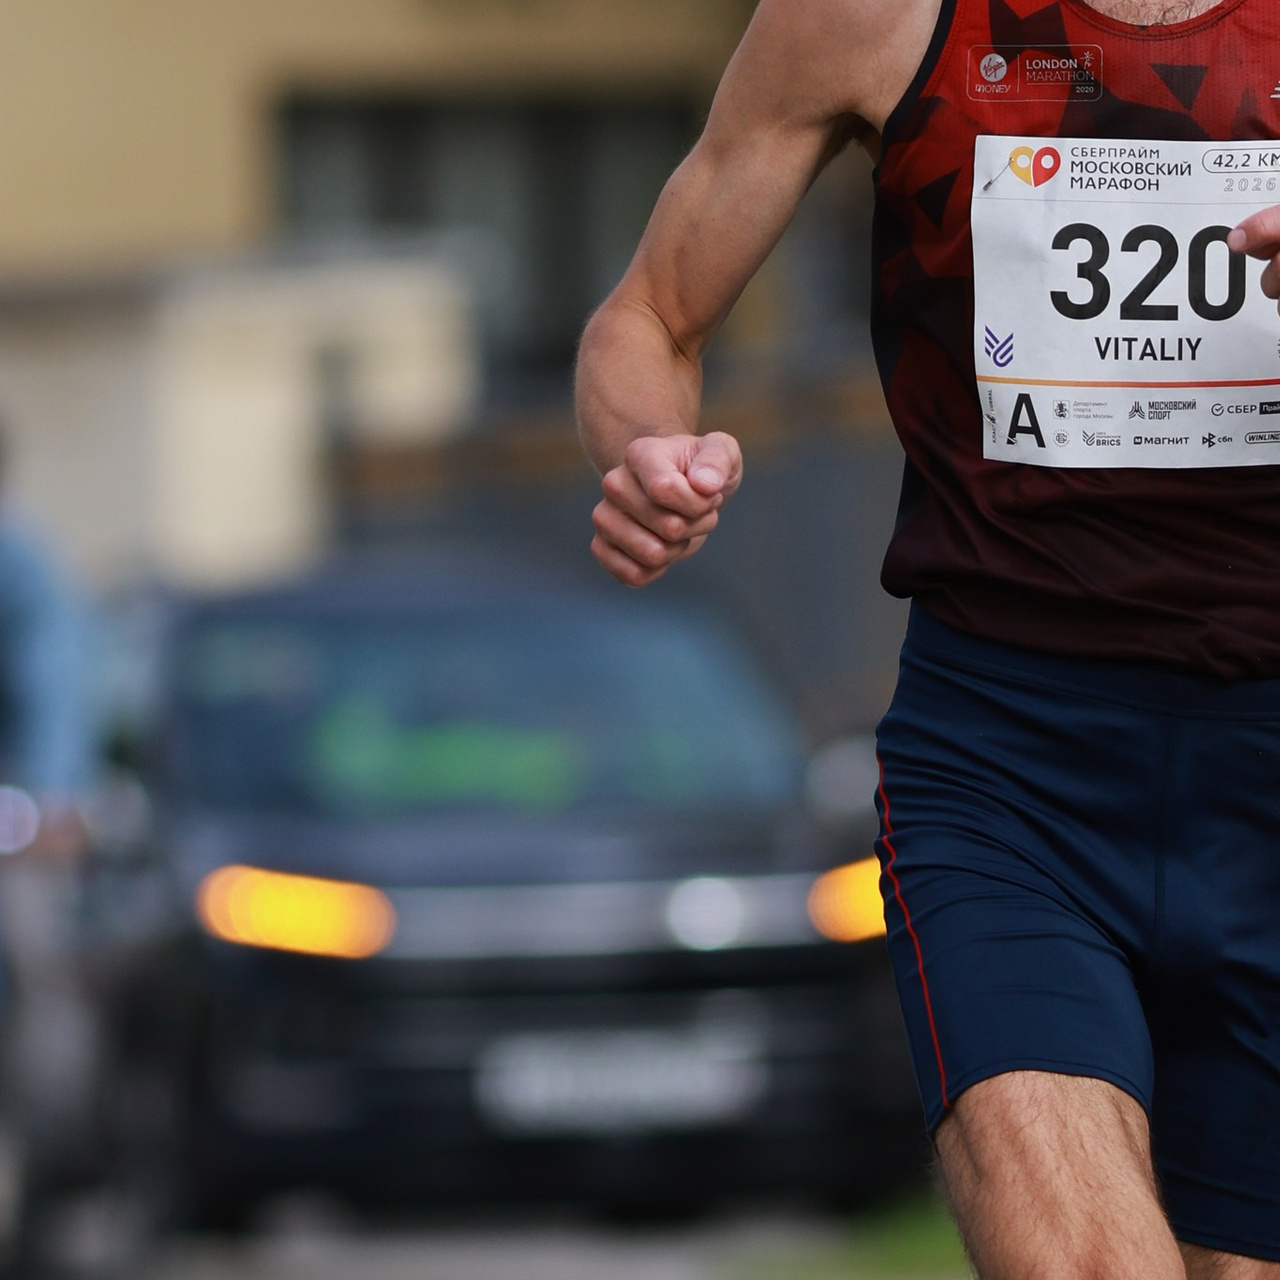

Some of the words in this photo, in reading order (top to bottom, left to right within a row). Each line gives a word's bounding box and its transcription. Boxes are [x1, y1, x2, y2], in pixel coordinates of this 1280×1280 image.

[1026, 59, 1078, 70] LONDON
[1026, 71, 1095, 81] MARATHON
[1071, 146, 1160, 159] СБЕРПРАЙМ
[1213, 153, 1251, 169] 42,2
[1070, 160, 1192, 176] МОСКОВСКИЙ
[1070, 176, 1160, 191] МАРАФОН
[1223, 177, 1277, 192] 2026
[1050, 222, 1247, 321] 320
[1094, 336, 1203, 362] VITALIY
[1148, 399, 1197, 410] МОСКОВСКИЙ
[1227, 404, 1257, 414] СБЕР
[1148, 411, 1171, 420] СПОРТ
[1144, 436, 1190, 445] магнит
[1217, 435, 1233, 443] сбп
